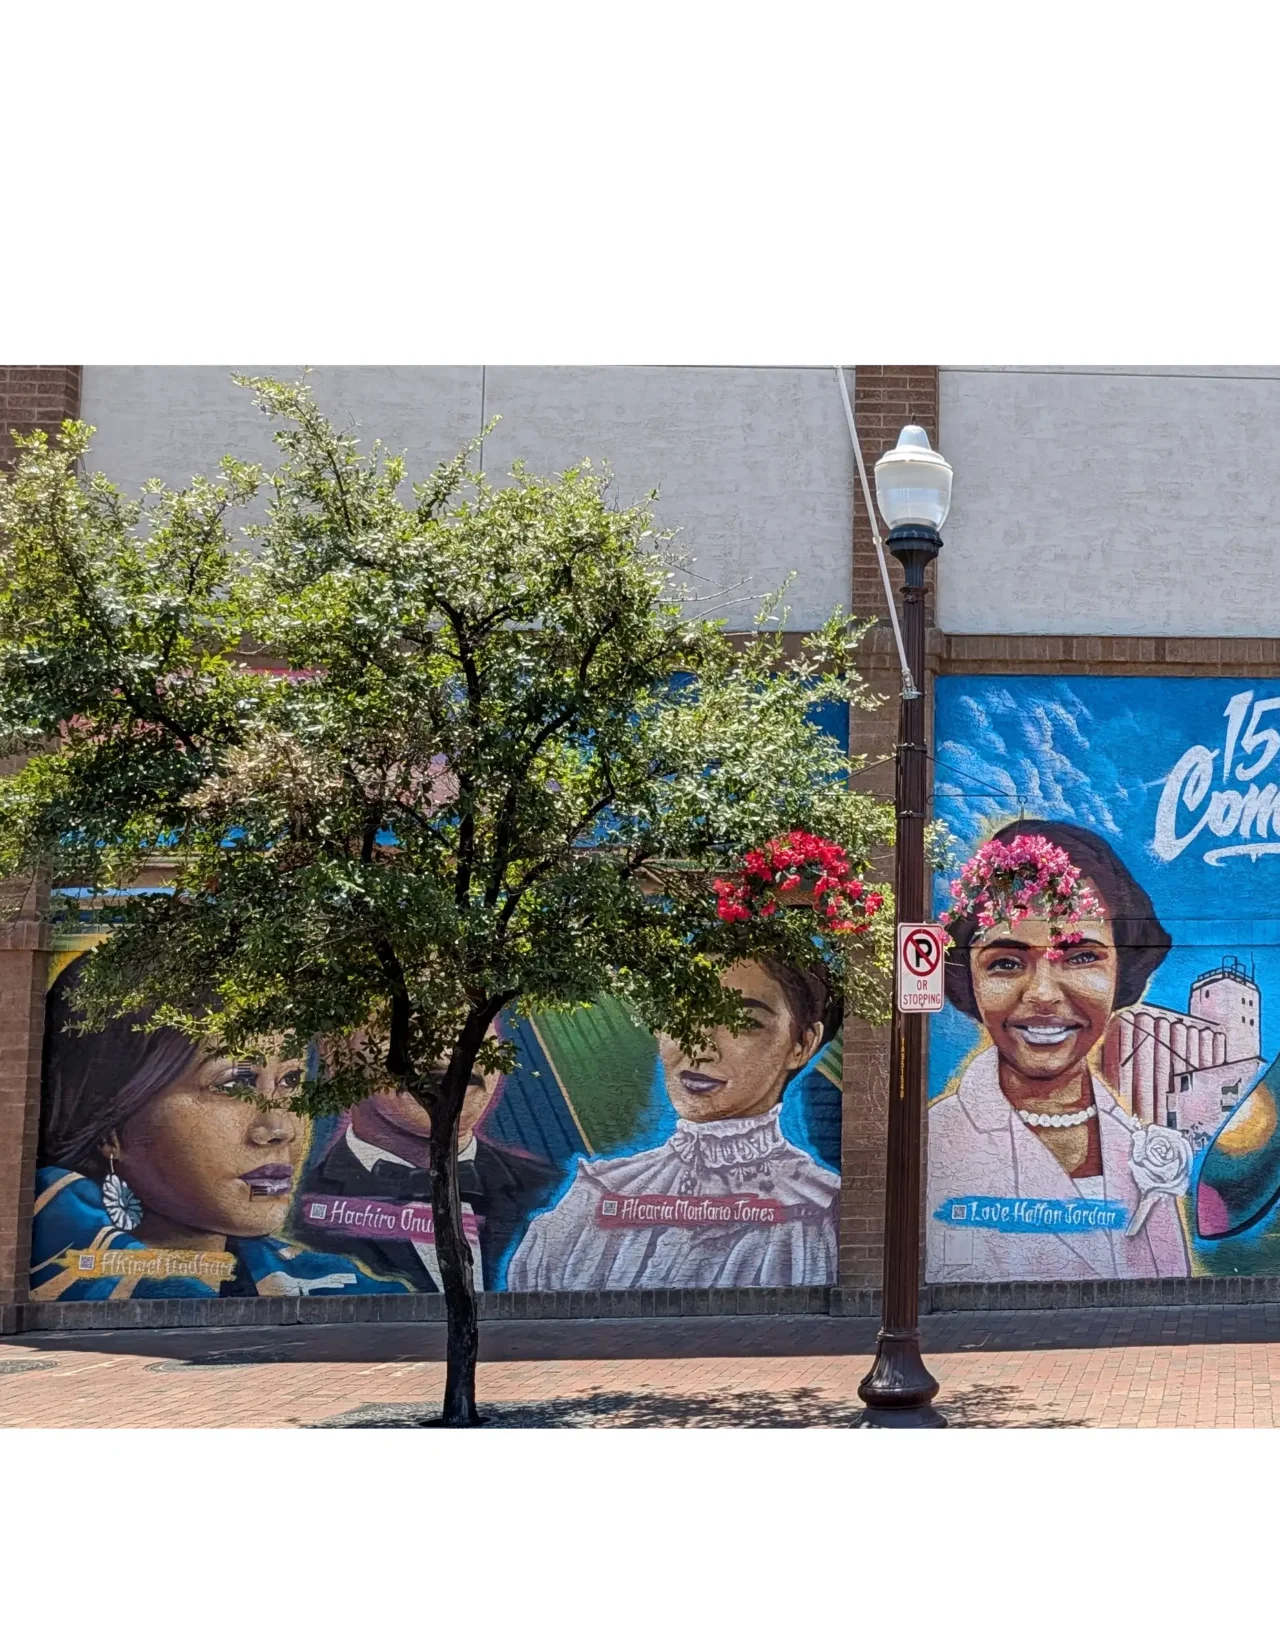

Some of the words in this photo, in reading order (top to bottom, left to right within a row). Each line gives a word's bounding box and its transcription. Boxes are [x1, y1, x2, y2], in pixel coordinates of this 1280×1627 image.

[915, 938, 932, 967] P
[916, 979, 928, 991] OR
[903, 993, 941, 1005] STOPPING
[330, 1200, 396, 1229] Hachiro
[733, 1200, 775, 1222] Jones
[968, 1201, 1010, 1223] Love
[1064, 1203, 1117, 1225] Jordan
